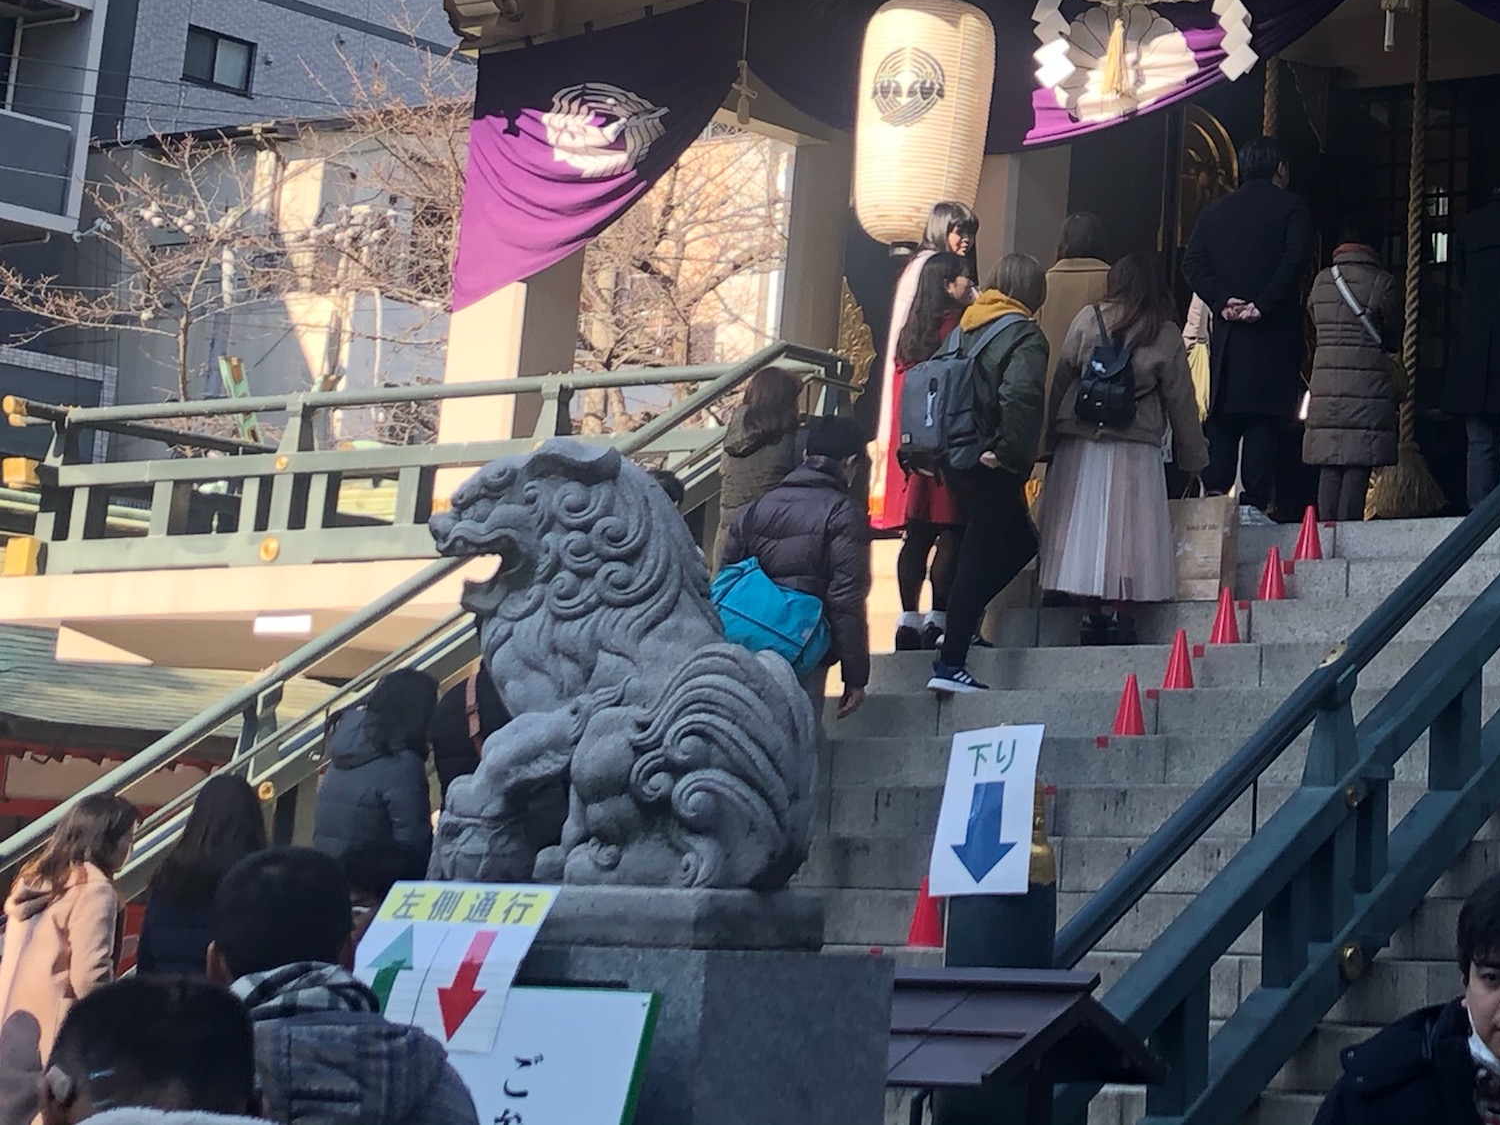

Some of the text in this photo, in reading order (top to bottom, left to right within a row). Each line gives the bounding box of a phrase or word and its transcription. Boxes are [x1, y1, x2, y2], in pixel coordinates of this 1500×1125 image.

[967, 739, 1017, 777] 下り
[391, 887, 539, 924] 左側通行
